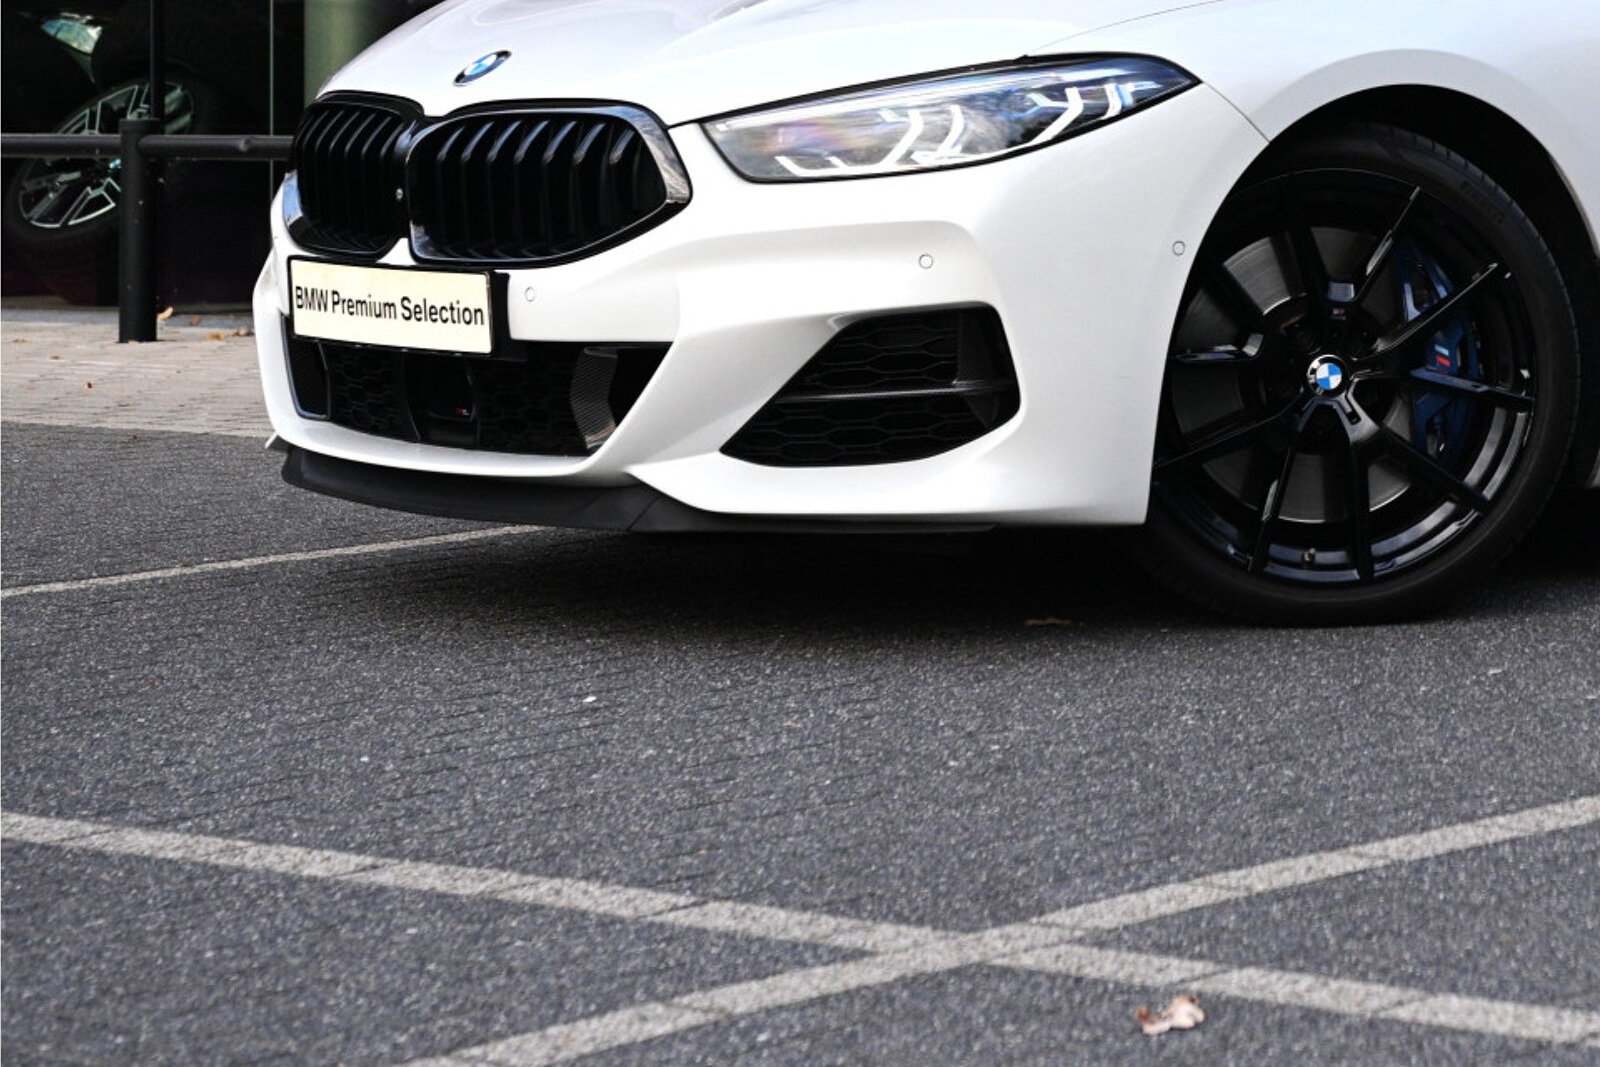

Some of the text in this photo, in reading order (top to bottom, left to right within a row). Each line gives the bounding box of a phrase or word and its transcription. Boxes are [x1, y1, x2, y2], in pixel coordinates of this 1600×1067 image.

[296, 286, 484, 325] BMW Premium Selection
